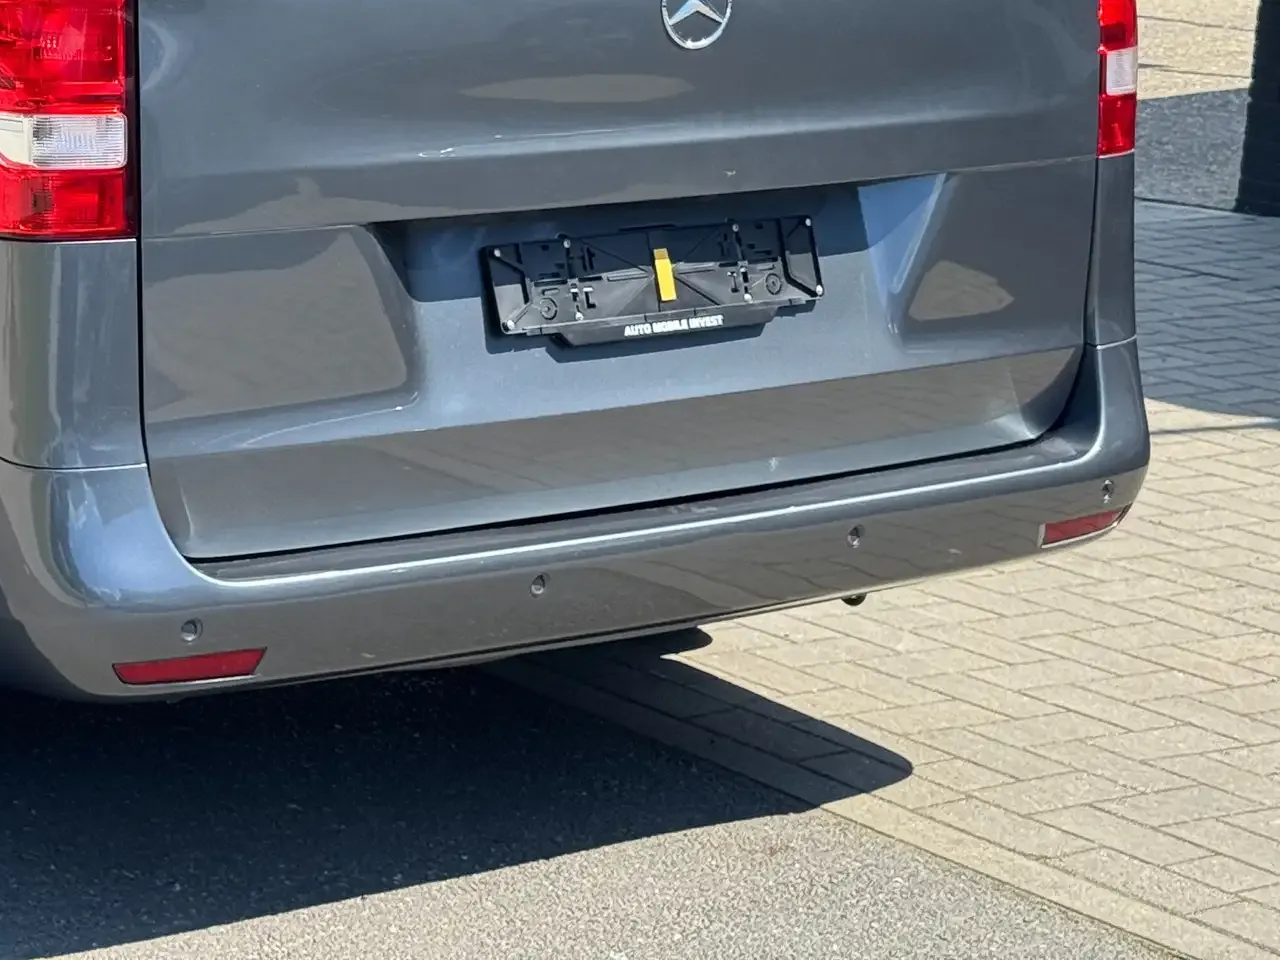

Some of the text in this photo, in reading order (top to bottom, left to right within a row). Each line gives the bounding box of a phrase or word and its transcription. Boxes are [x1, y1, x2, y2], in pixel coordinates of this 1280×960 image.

[624, 314, 724, 337] AUTO MOBILE INVEST
